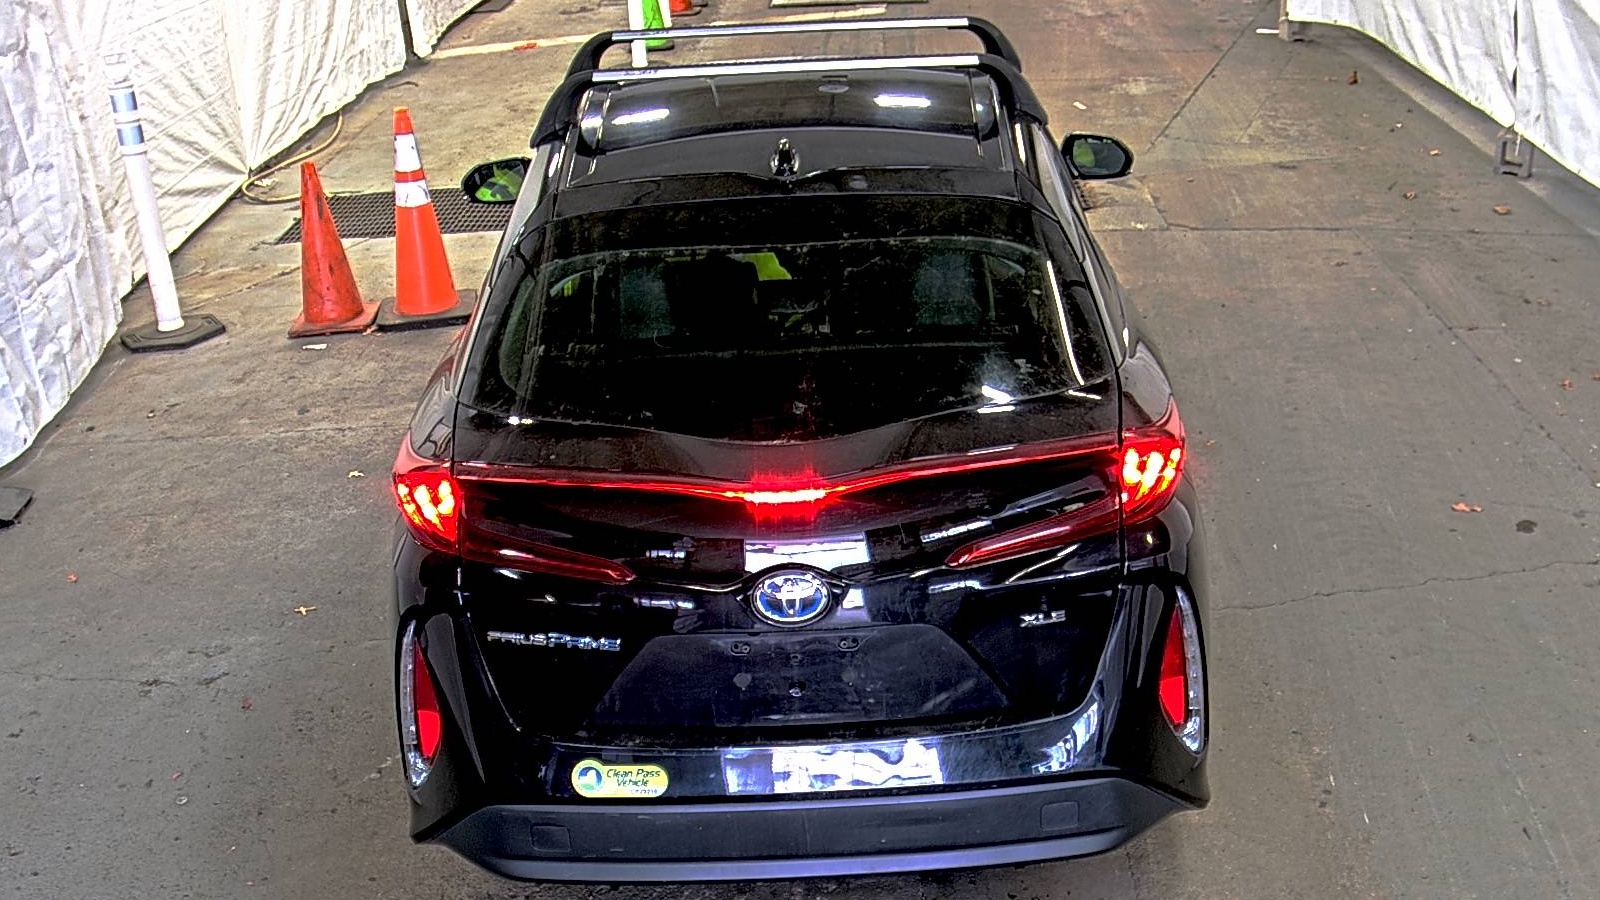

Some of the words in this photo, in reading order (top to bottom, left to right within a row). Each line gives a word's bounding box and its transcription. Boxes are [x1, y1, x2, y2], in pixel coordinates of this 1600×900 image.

[1019, 610, 1066, 627] XLE
[607, 768, 633, 778] Clean
[636, 768, 661, 778] Pass
[617, 778, 649, 787] Vehicle
